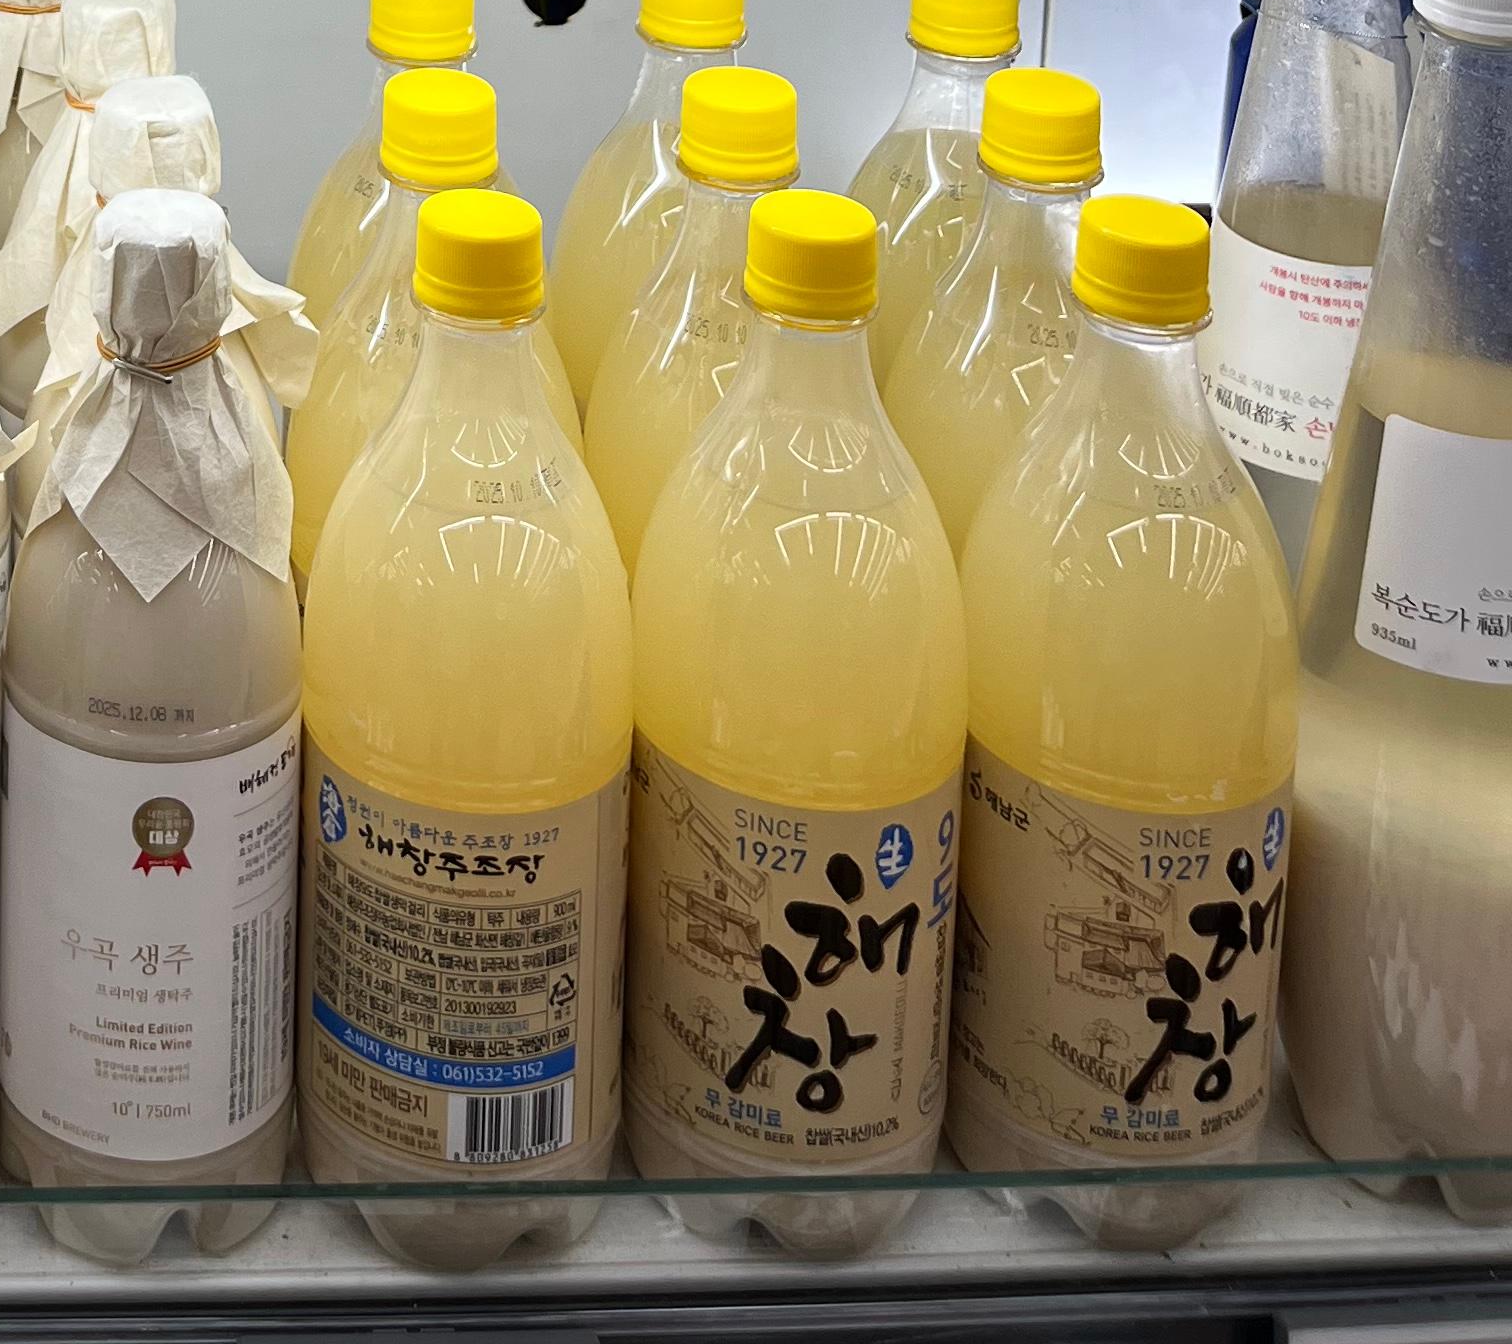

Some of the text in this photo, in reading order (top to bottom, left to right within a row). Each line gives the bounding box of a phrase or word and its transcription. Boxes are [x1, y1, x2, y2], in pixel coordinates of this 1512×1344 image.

[1214, 383, 1297, 433] 福順都家
[1371, 582, 1471, 633] 복순도가
[1371, 622, 1416, 650] 935ml
[88, 697, 168, 723] 2025.12.08
[735, 808, 808, 842] SINCE
[1139, 826, 1212, 848] SINCE
[358, 823, 545, 884] 해창주조장
[462, 834, 513, 851] 주조장
[524, 828, 560, 847] 1927
[735, 836, 808, 875] 1927
[1139, 854, 1209, 881] 1927
[61, 929, 195, 977] 우곡 생주
[96, 983, 149, 1003] 프리미엄
[69, 1023, 193, 1052] Premium Rice Wine
[96, 1016, 193, 1035] Limited Edition
[342, 1026, 544, 1085] 소비자 상담실 061)532-5152
[145, 1102, 192, 1119] 750ml
[705, 1088, 782, 1130] 무 감미료
[1100, 1106, 1180, 1128] 무 감미료
[62, 1118, 111, 1145] BREWERY
[695, 1106, 794, 1146] KOREA RICE BEER
